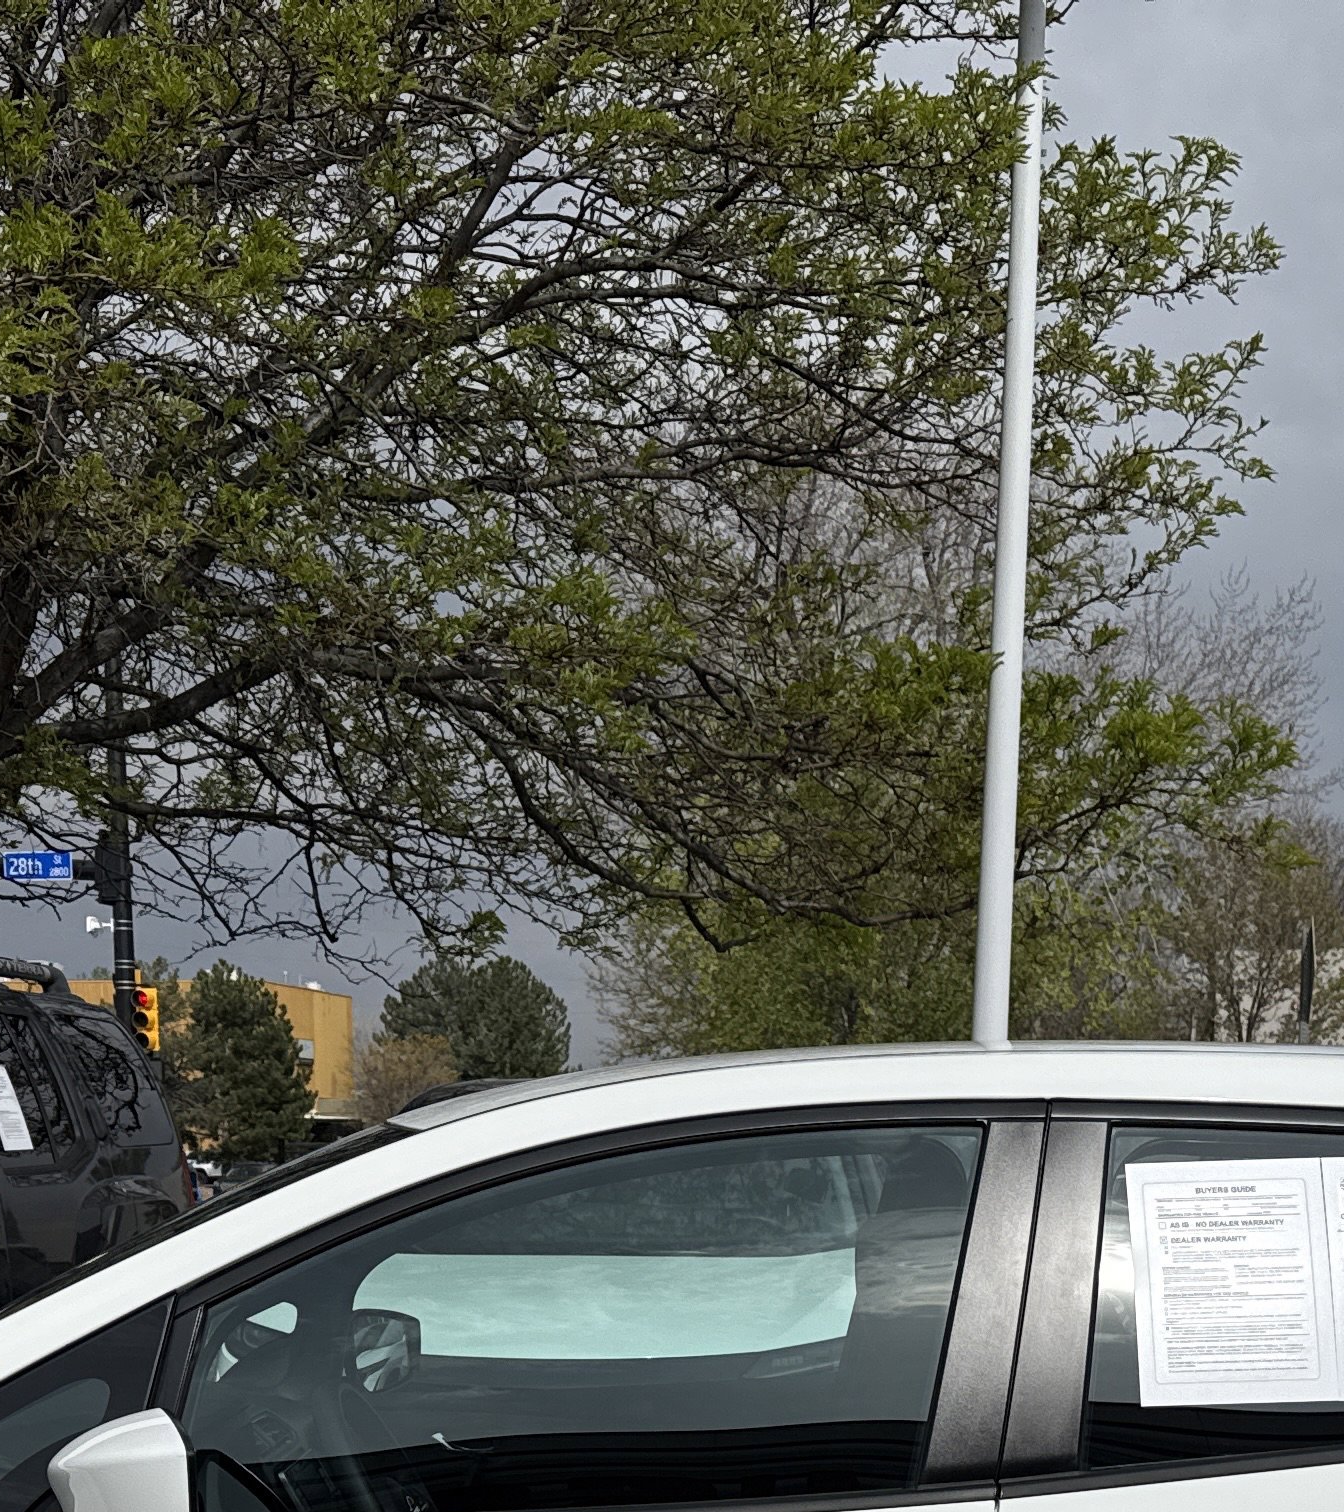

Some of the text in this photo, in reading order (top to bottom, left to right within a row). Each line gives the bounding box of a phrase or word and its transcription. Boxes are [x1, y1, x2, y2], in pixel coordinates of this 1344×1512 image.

[8, 857, 43, 876] 28th
[1230, 1185, 1256, 1193] GUIDE
[1208, 1220, 1240, 1228] DEALER
[1241, 1218, 1285, 1226] WARRANTY
[1170, 1235, 1247, 1244] DEALER WARRANTY
